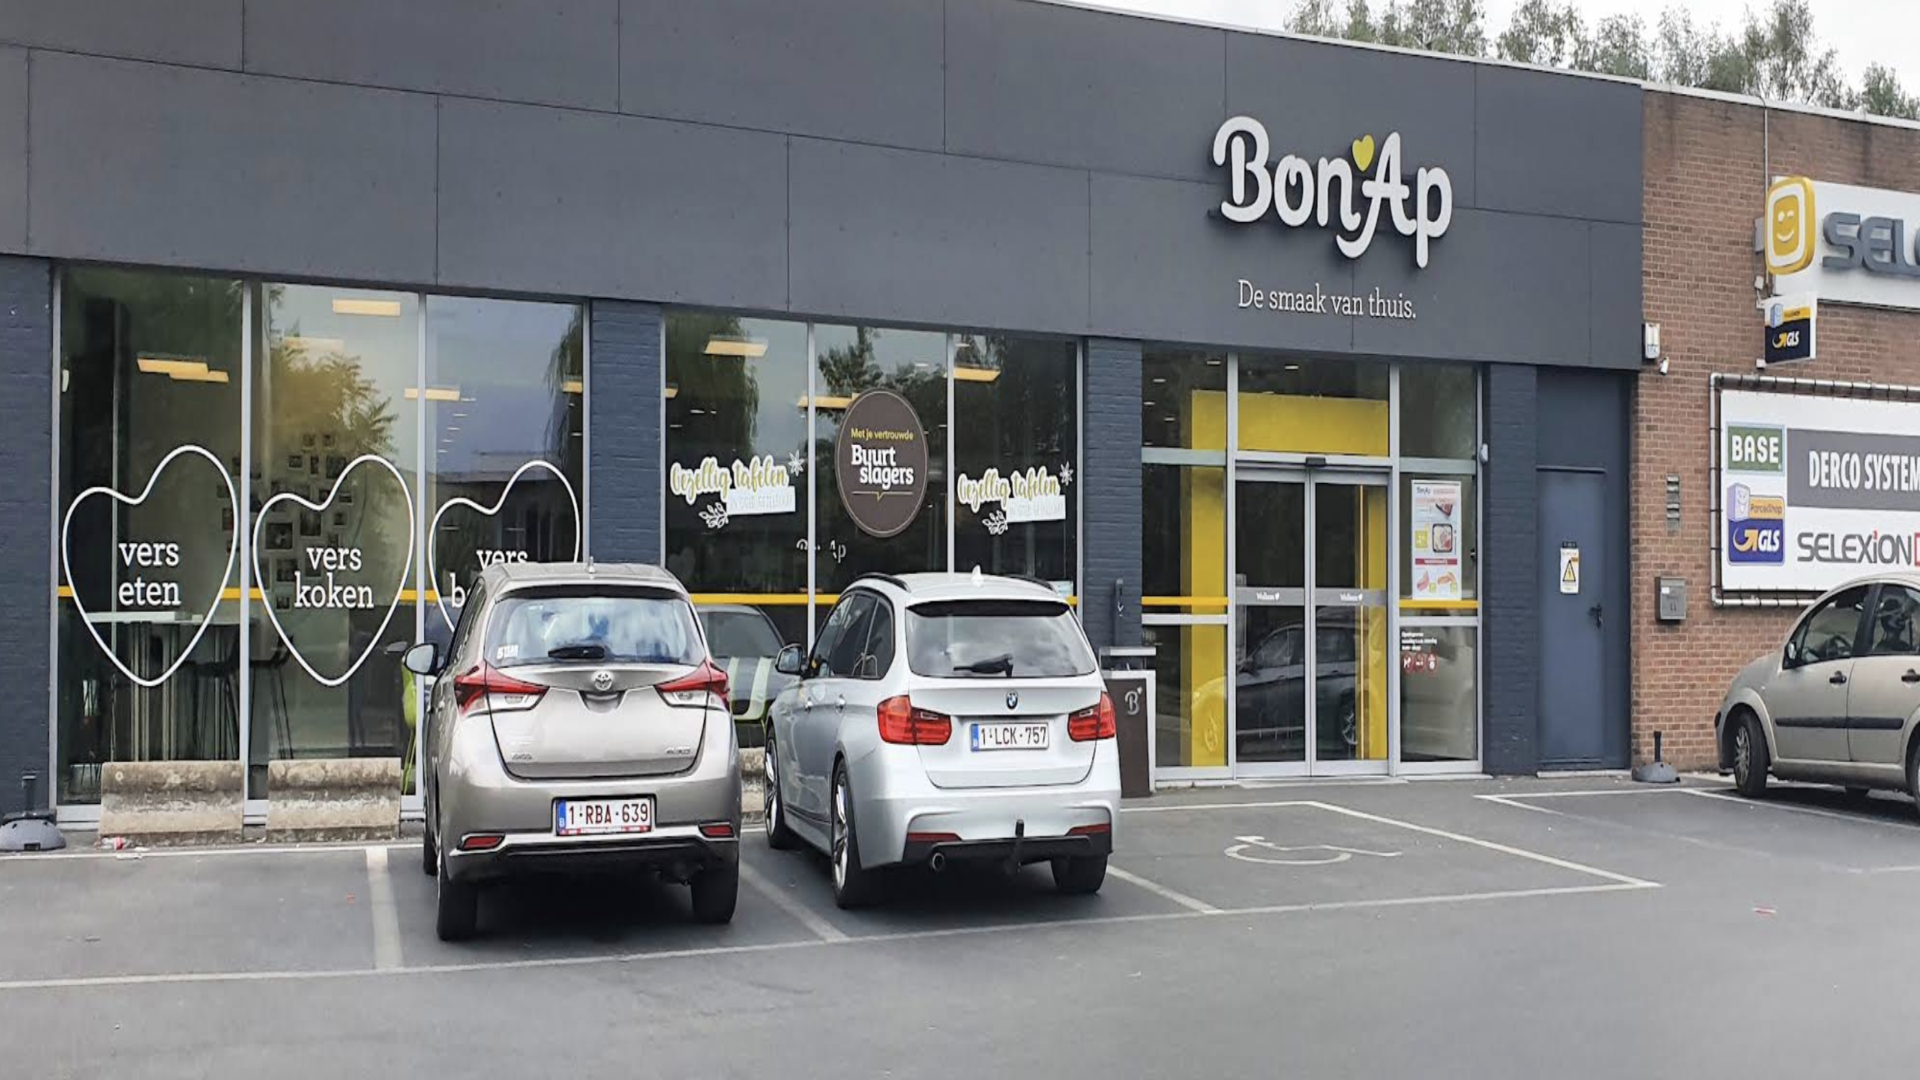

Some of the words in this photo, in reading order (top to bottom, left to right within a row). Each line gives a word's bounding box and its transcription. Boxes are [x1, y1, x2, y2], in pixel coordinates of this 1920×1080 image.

[1822, 212, 1920, 277] SEL
[1238, 279, 1264, 308] De
[1268, 282, 1327, 314] smaak
[1331, 297, 1364, 316] van
[1368, 286, 1417, 319] thuis.
[1786, 330, 1800, 347] GLS
[850, 427, 865, 440] Met
[865, 428, 873, 442] je
[874, 429, 914, 441] vertrouwde
[851, 444, 897, 466] Buurt
[1731, 434, 1779, 463] BASE
[859, 464, 914, 490] slagers
[1808, 450, 1861, 490] DERCO
[1757, 528, 1781, 553] GLS
[118, 542, 180, 567] vers
[306, 547, 362, 571] vers
[118, 576, 182, 606] eten
[294, 572, 375, 608] koken
